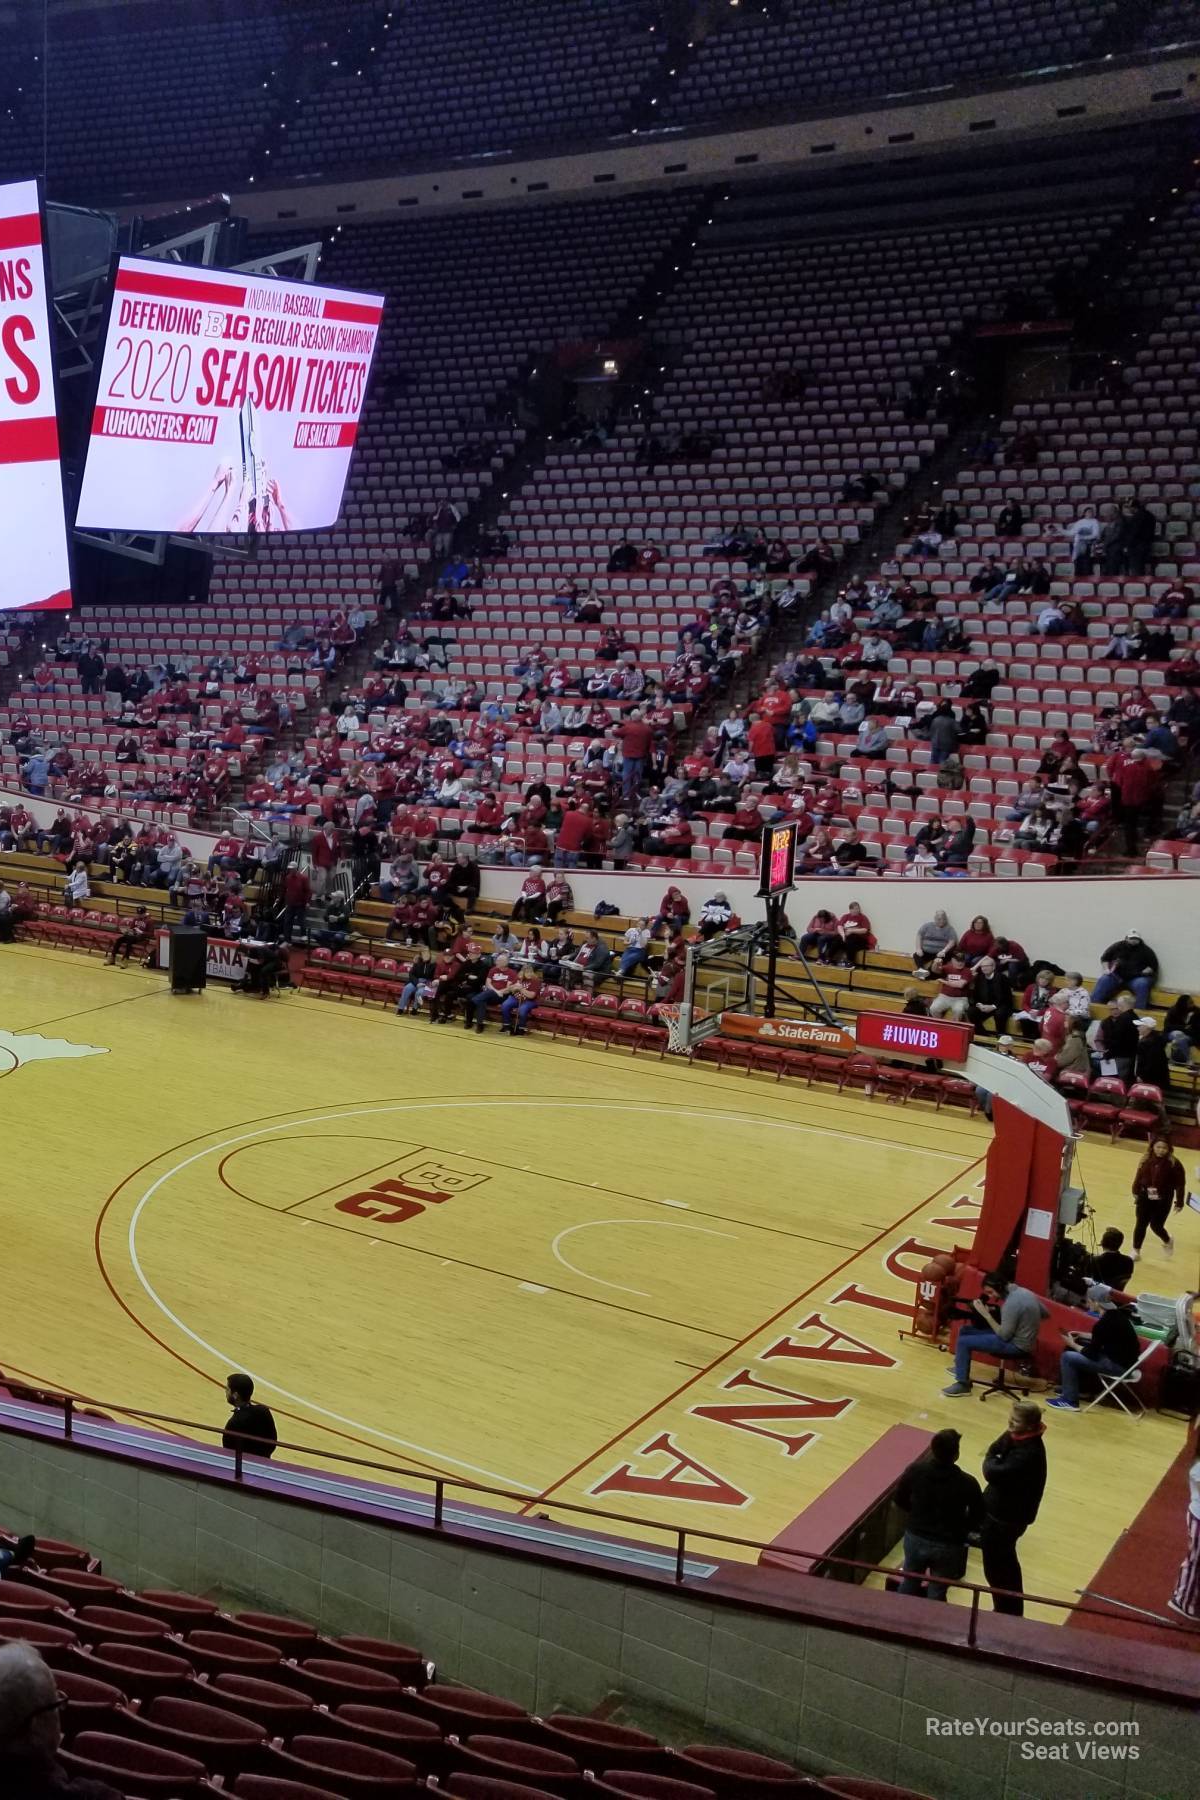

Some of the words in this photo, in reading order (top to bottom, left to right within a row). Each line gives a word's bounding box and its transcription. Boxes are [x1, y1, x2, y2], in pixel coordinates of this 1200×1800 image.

[247, 287, 282, 310] INDIANA
[282, 293, 321, 318] BASEBALL
[118, 298, 202, 336] DEFENDING
[251, 317, 301, 348] REGULAR
[301, 322, 335, 351] SEASON
[108, 336, 192, 404] 2020
[196, 347, 302, 413] SEASON
[300, 357, 367, 415] TICKETS
[102, 410, 214, 443] IUHOOSIERS.COM
[307, 423, 328, 446] SALE
[883, 1024, 938, 1049] #IUWBB
